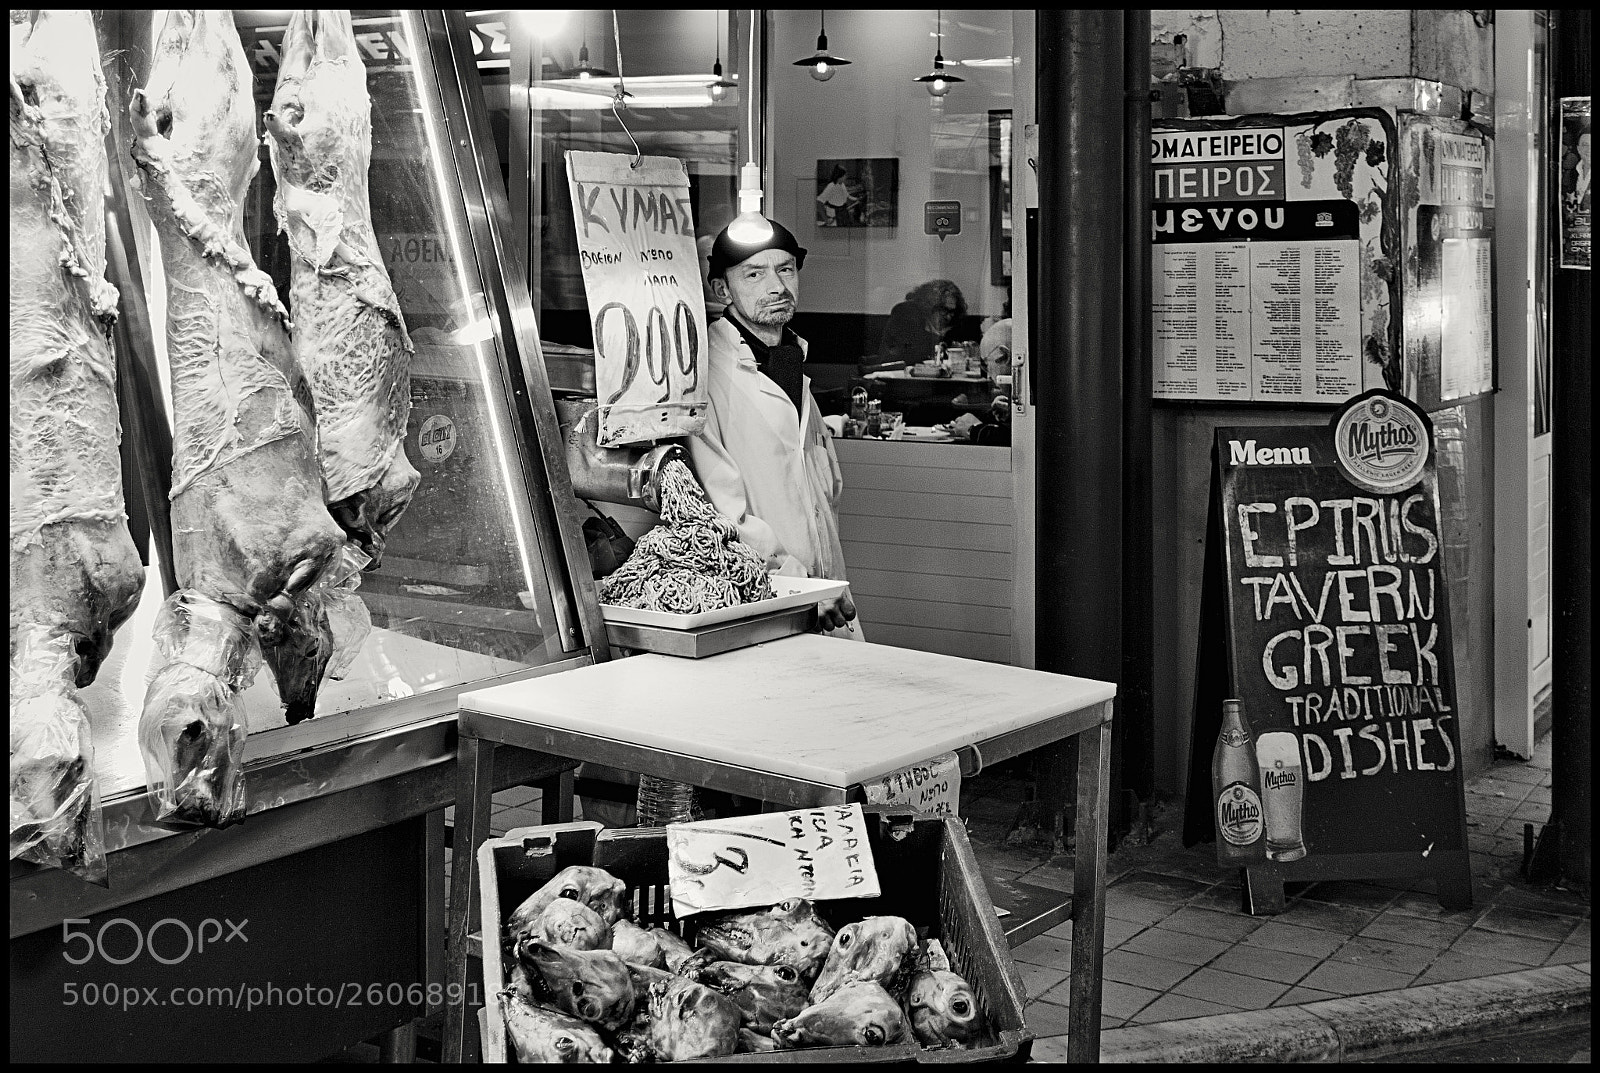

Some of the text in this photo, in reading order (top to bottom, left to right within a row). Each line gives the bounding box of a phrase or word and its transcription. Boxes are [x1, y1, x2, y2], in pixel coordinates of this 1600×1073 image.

[1154, 165, 1275, 198] ΠΕΙΡΟΣ
[577, 183, 695, 238] ΚΥΜΑΣ
[1152, 207, 1285, 241] μενου
[1229, 440, 1312, 466] Menu
[1349, 422, 1417, 461] Mythos
[1237, 494, 1438, 567] EPIRUS
[1240, 565, 1436, 623] TAVERN
[1262, 622, 1439, 690] GREEK
[1285, 685, 1451, 726] TRADITIONAL
[1302, 715, 1456, 782] DISHES
[1265, 771, 1296, 789] Mythos
[1222, 802, 1260, 828] Mythos
